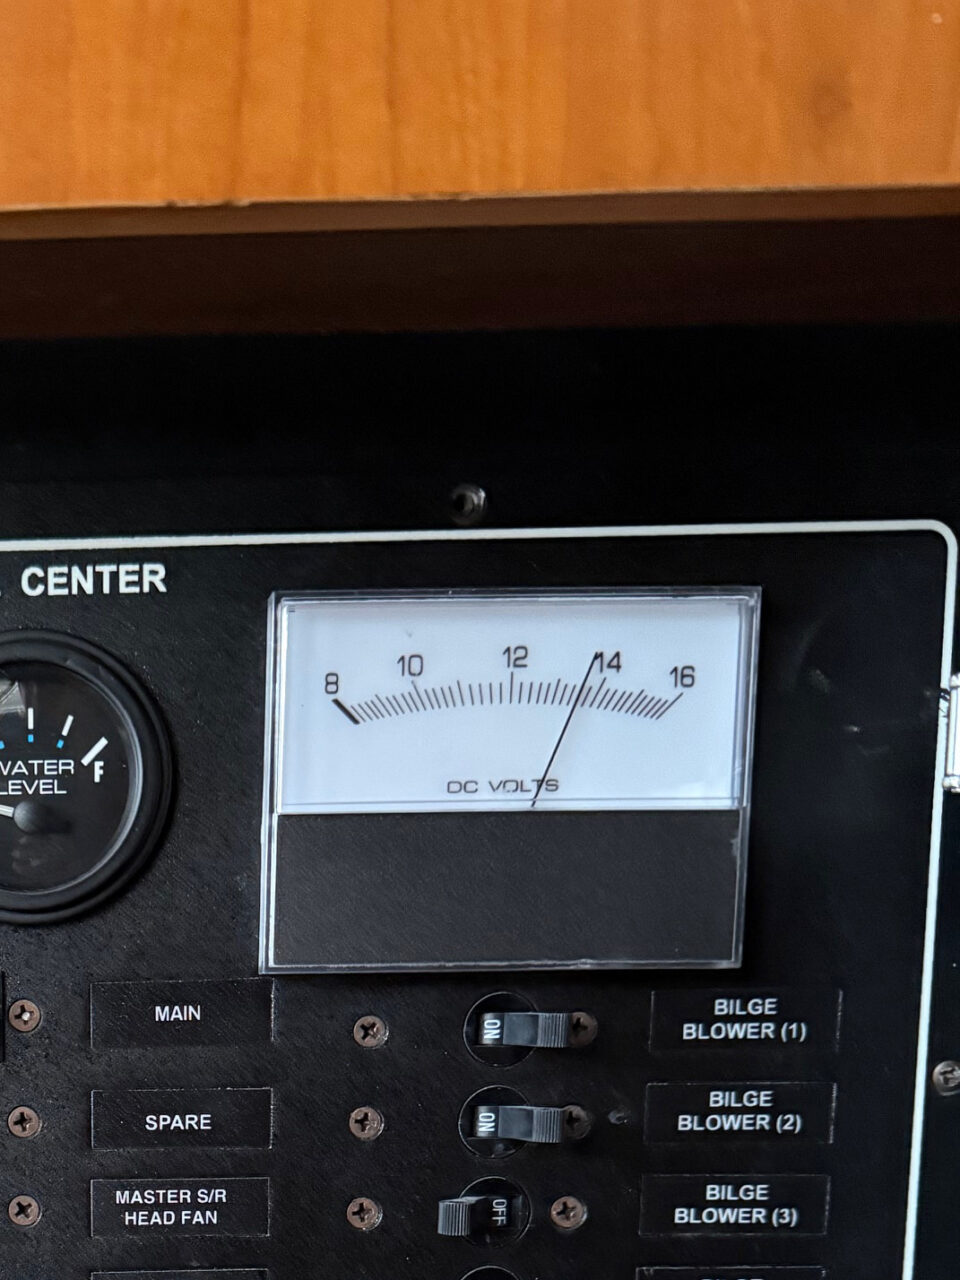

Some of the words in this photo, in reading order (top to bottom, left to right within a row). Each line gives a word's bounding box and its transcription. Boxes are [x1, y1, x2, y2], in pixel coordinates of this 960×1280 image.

[20, 563, 167, 597] CENTER
[397, 654, 424, 677] 10
[502, 646, 529, 668] 12
[594, 652, 622, 673] 14
[325, 673, 339, 694] 8
[670, 666, 695, 688] 16
[94, 761, 104, 783] F
[447, 780, 478, 794] DC
[488, 778, 560, 793] VOLTS
[154, 1005, 201, 1021] MAIN
[714, 999, 778, 1015] BILGE
[484, 1019, 500, 1040] ON
[682, 1022, 775, 1040] BLOWER
[781, 1022, 806, 1042] (1)
[709, 1091, 773, 1107] BILGE
[145, 1114, 212, 1131] SPARE
[478, 1112, 495, 1132] ON
[677, 1114, 770, 1131] BLOWER
[776, 1114, 801, 1134] (2)
[115, 1190, 191, 1205] MASTER
[196, 1189, 227, 1204] S/R
[706, 1184, 769, 1200] BILGE
[124, 1211, 176, 1226] HEAD
[181, 1210, 218, 1225] FAN
[493, 1198, 507, 1226] OFF
[674, 1208, 766, 1224] BLOWER
[772, 1208, 797, 1227] (3)
